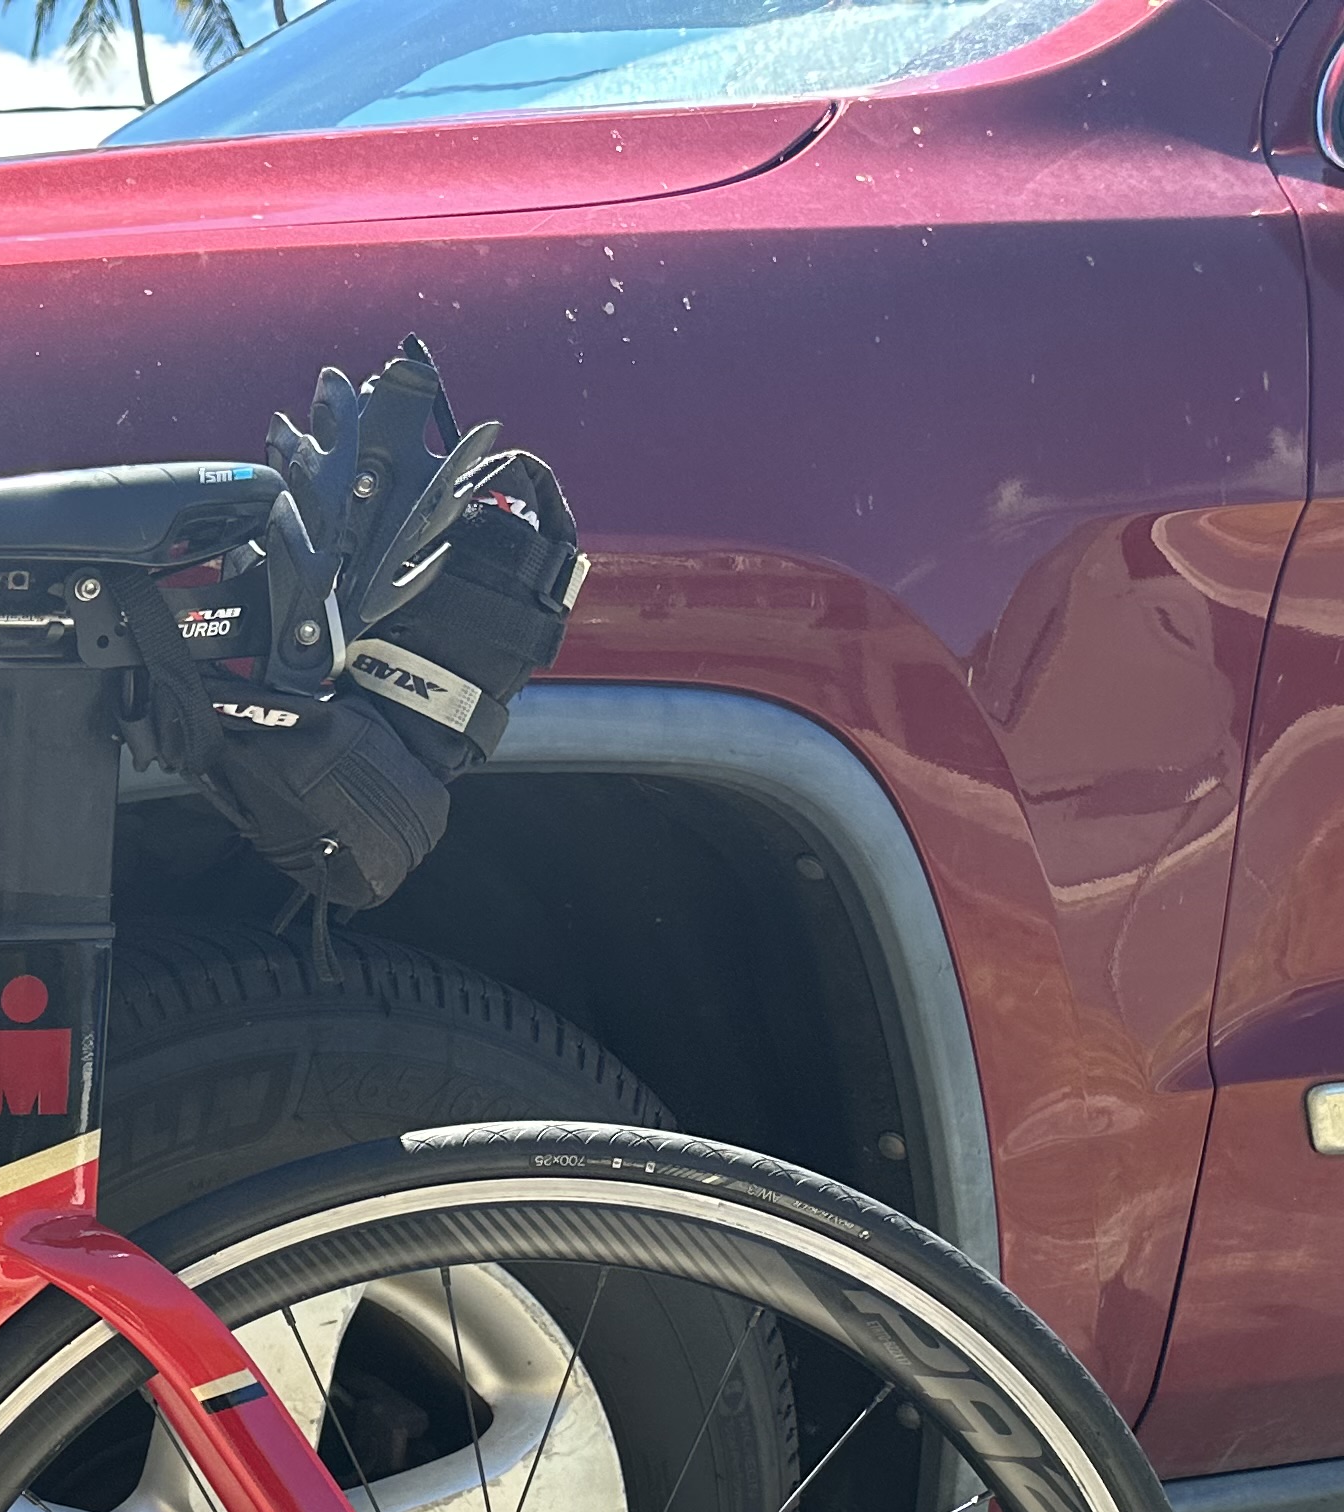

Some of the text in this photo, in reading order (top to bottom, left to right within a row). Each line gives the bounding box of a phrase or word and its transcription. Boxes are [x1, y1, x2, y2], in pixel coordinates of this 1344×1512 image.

[477, 490, 540, 532] XLA
[352, 652, 450, 700] XLAB
[534, 1155, 586, 1168] 700x25
